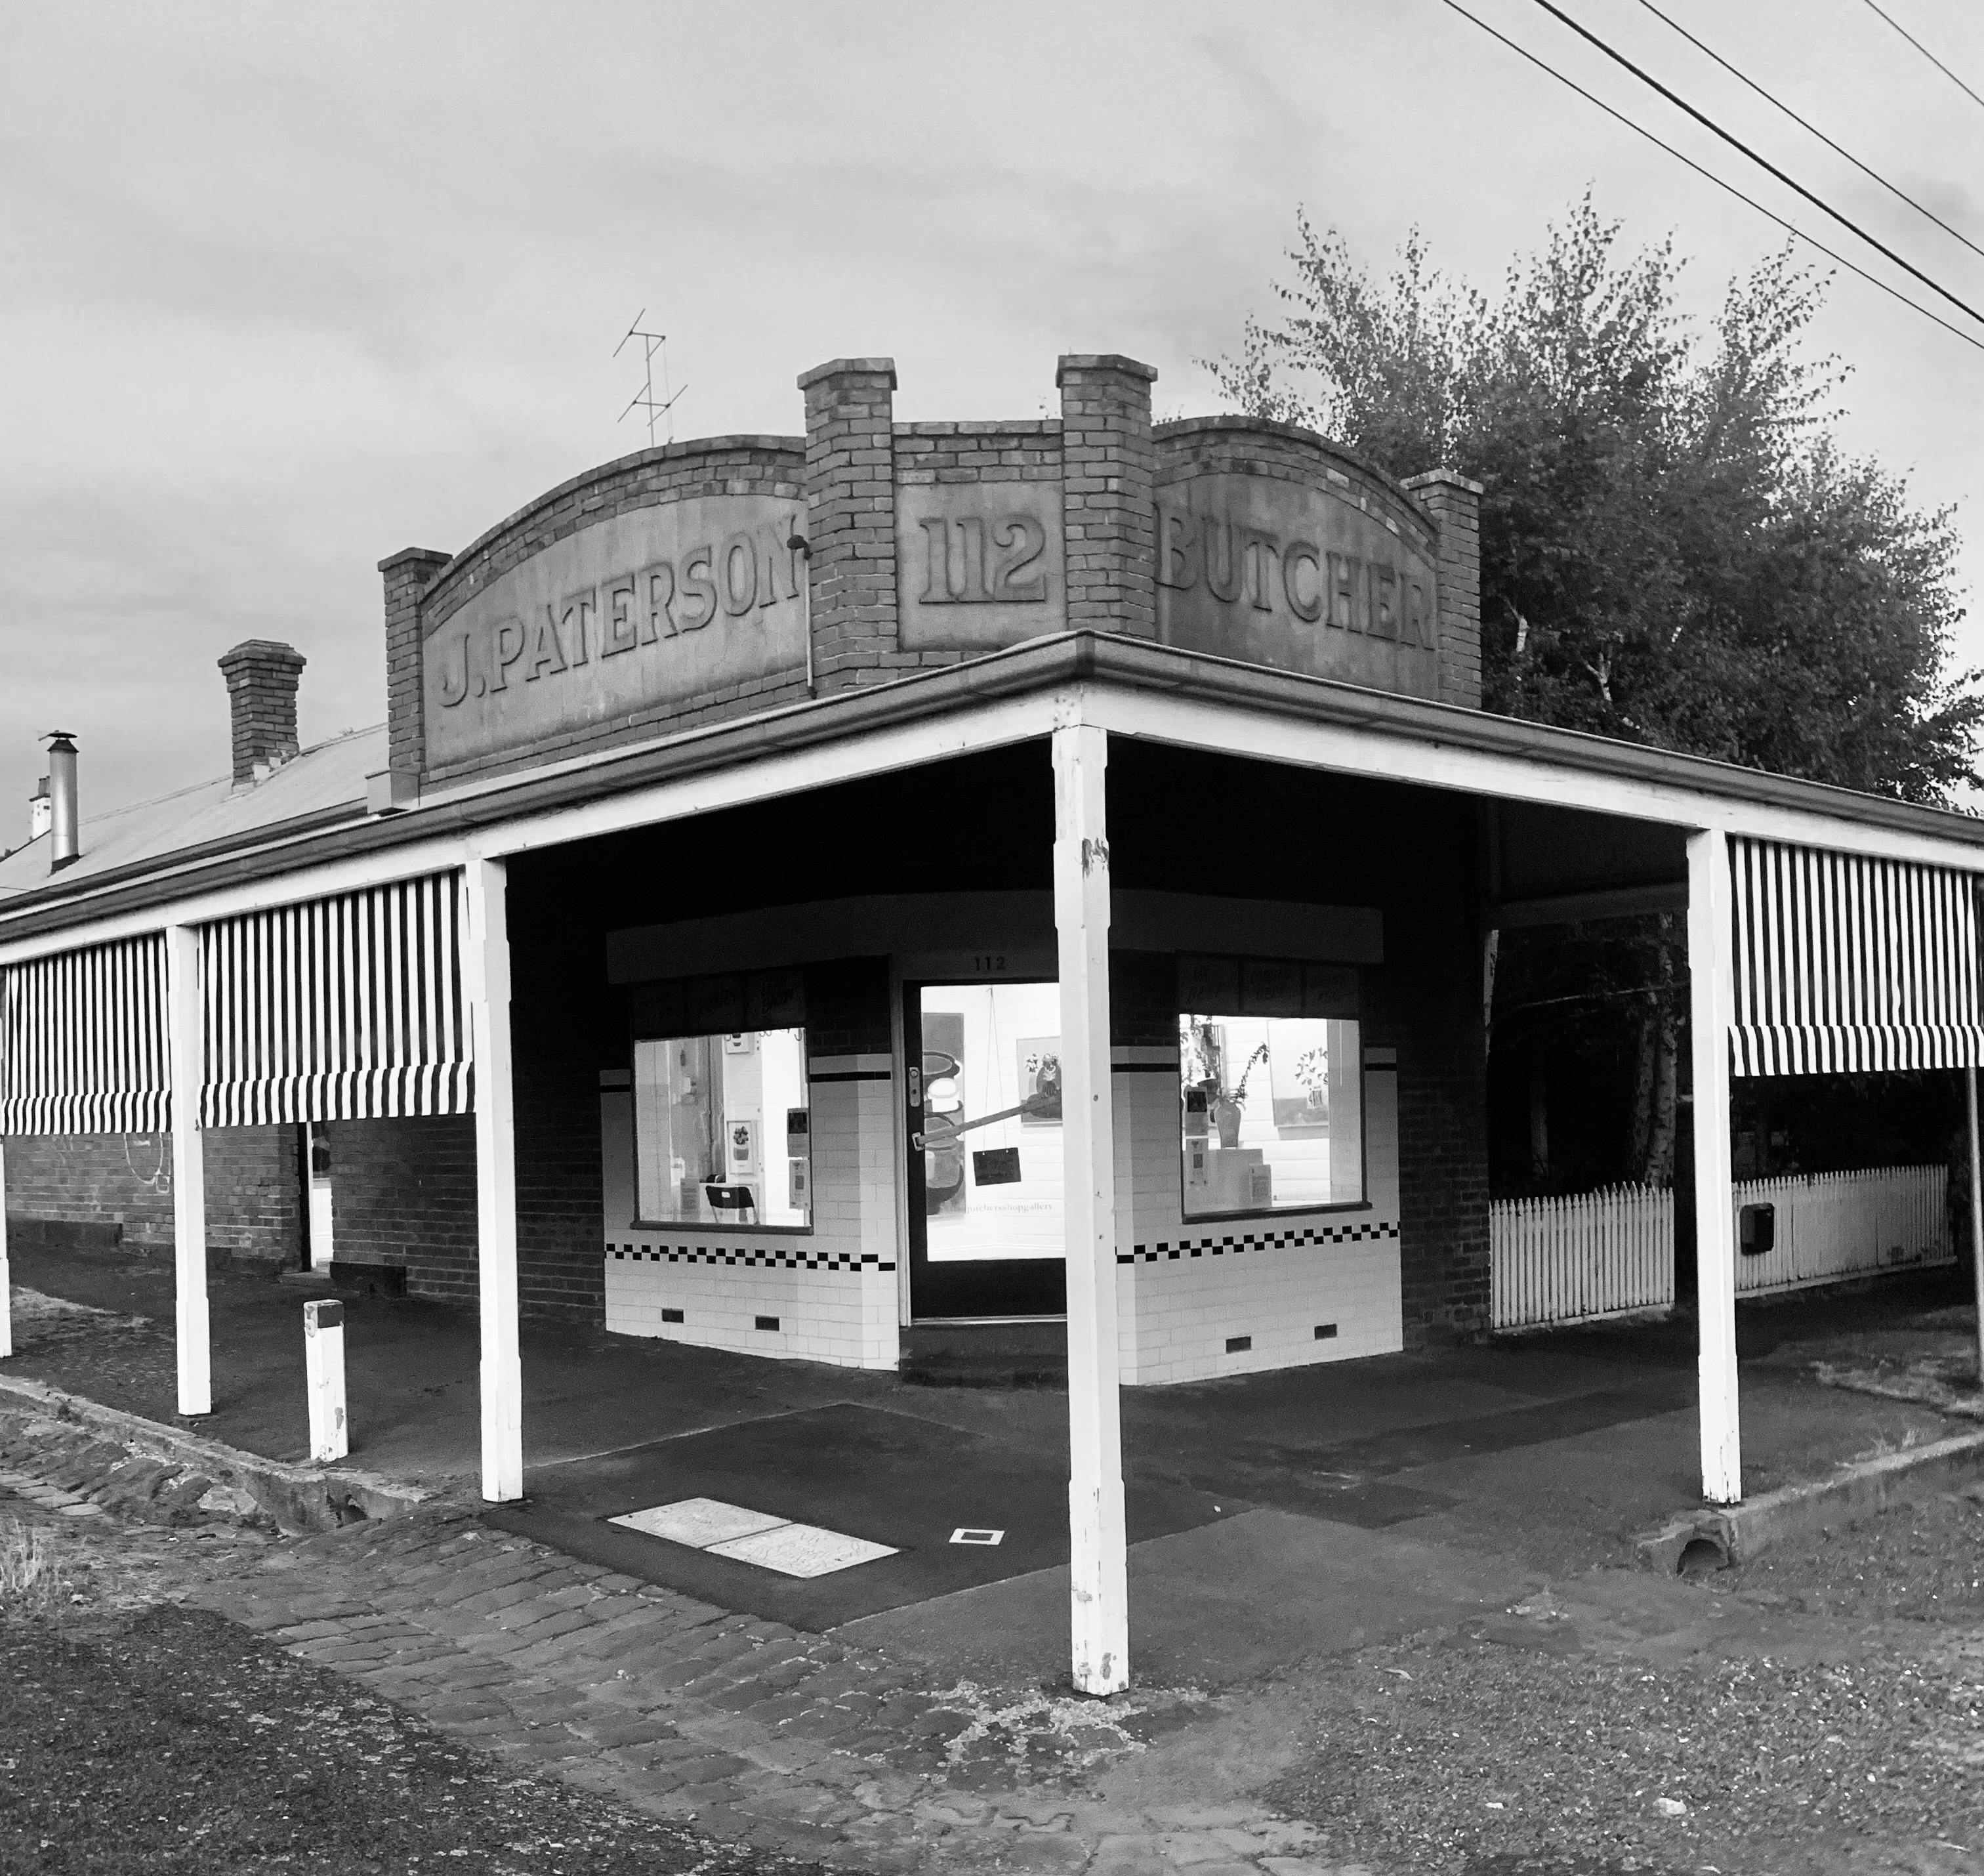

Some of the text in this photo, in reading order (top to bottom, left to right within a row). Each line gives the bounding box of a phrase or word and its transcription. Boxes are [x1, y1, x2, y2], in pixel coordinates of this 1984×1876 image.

[918, 511, 1047, 604] 112
[1153, 500, 1436, 650] BUTCHER
[974, 955, 1006, 970] 112
